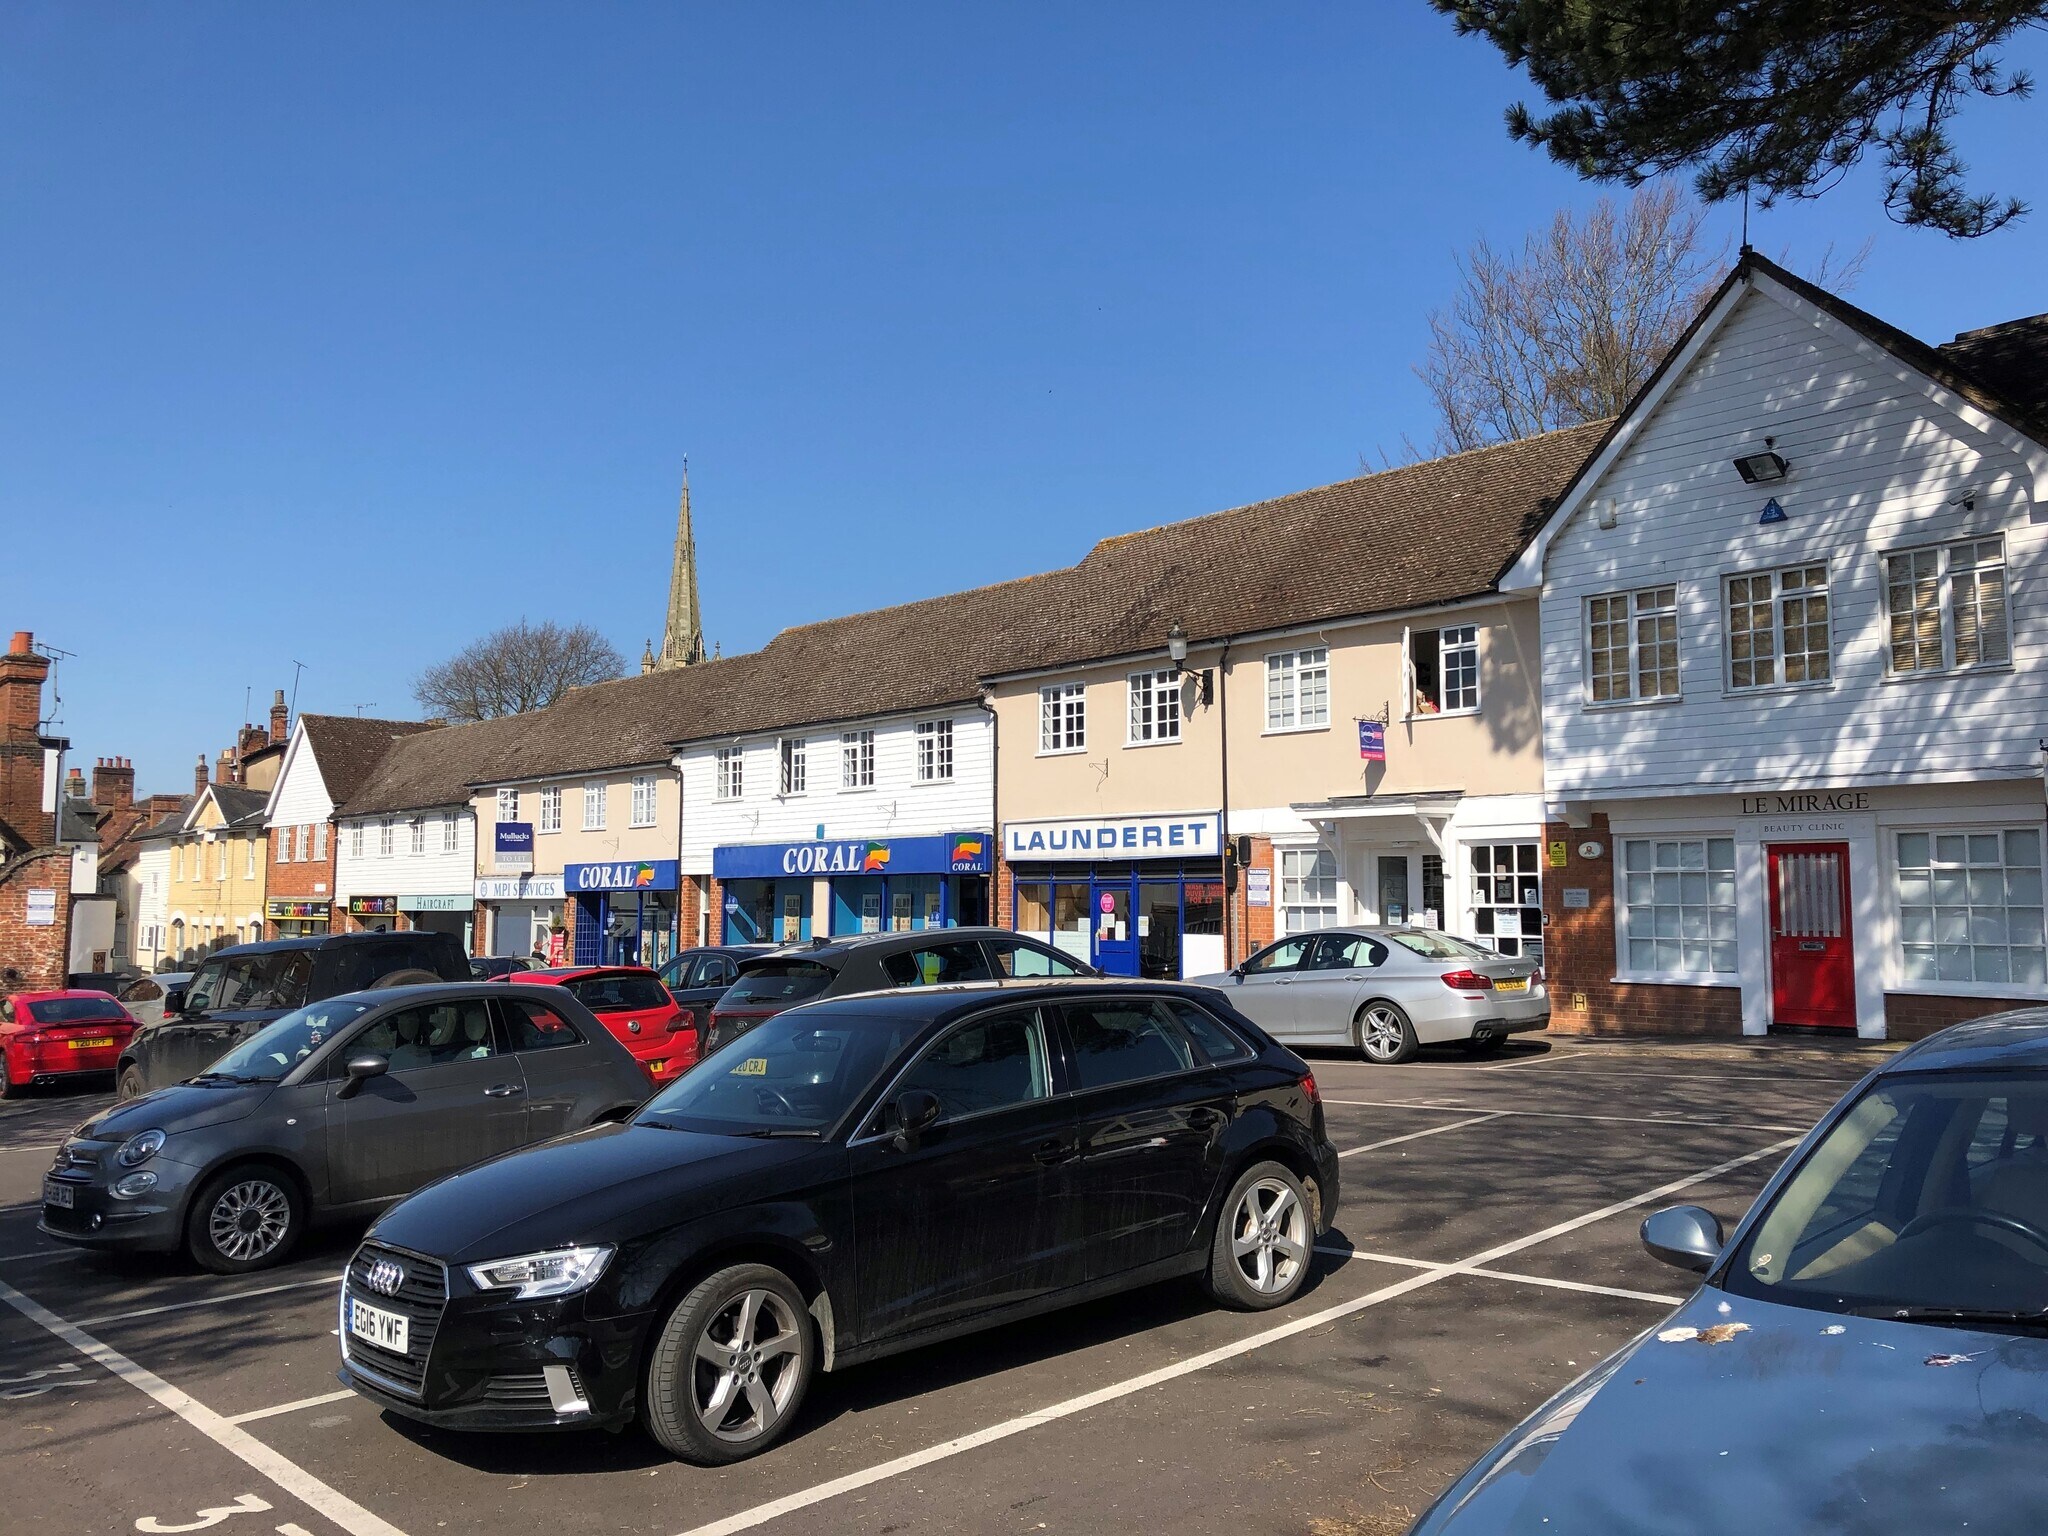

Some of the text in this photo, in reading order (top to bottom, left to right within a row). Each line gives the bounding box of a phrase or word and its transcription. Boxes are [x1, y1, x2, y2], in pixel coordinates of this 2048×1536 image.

[1742, 793, 1869, 814] LE MIRAGE
[1764, 823, 1845, 832] BEAUTY CLINIC
[1013, 823, 1208, 851] LAUNDERET
[782, 845, 862, 874] CORAL
[952, 862, 983, 871] CORAL
[579, 865, 635, 889] CORAL
[493, 882, 555, 896] MPI SERVICES
[284, 903, 313, 917] colorcraft
[353, 898, 383, 912] colorcraft
[1574, 995, 1584, 1010] H
[748, 1060, 764, 1072] CRJ
[378, 1313, 403, 1346] YWF
